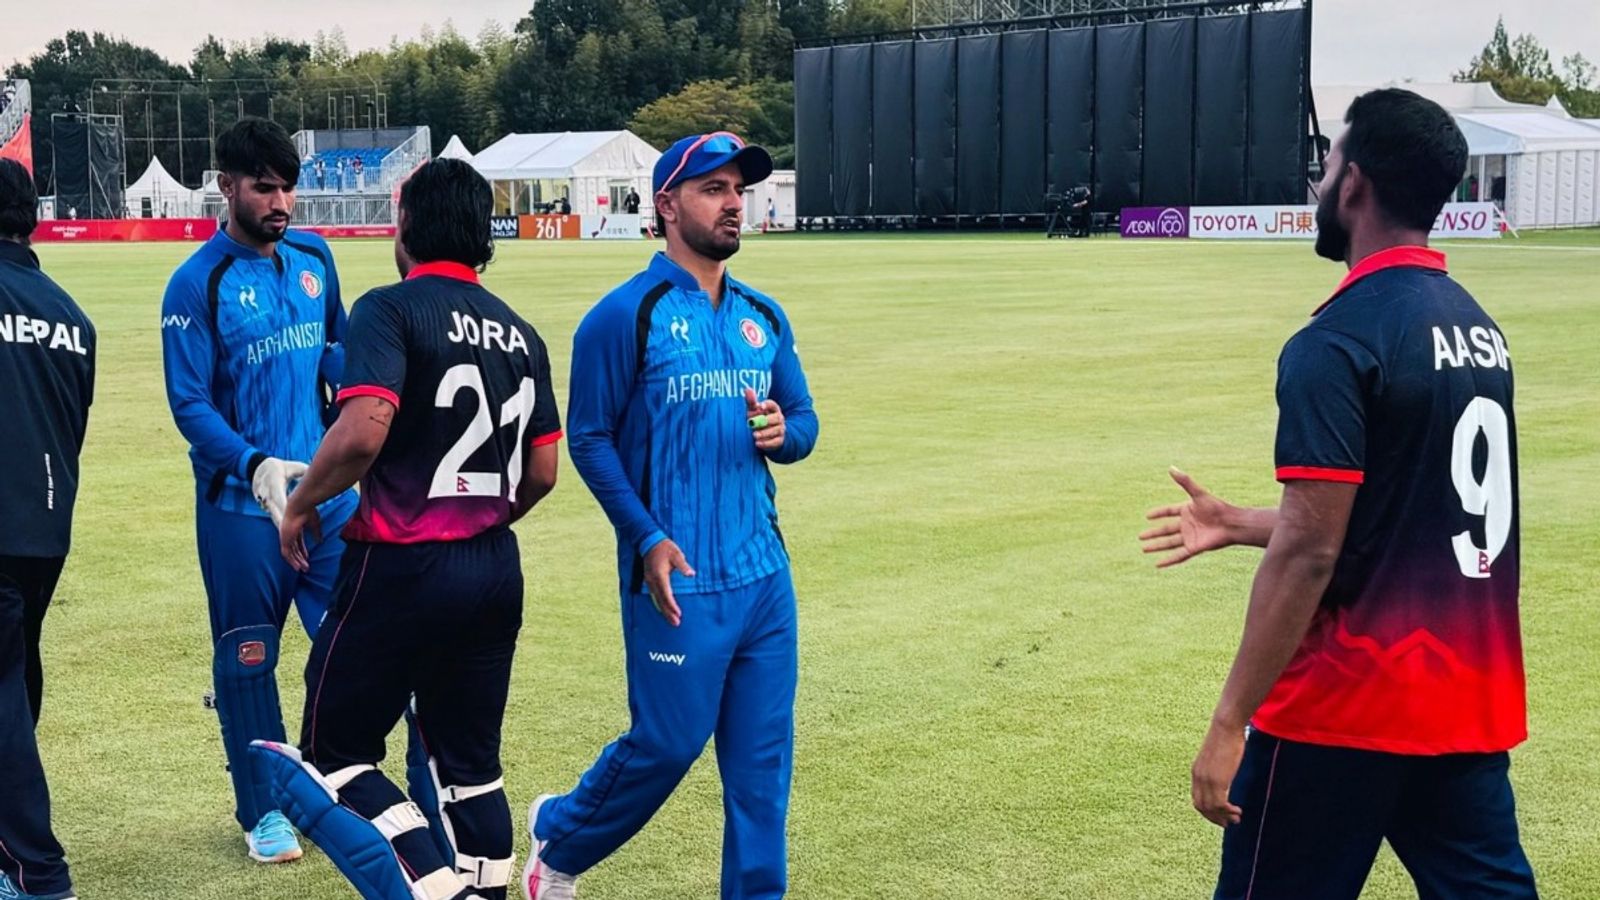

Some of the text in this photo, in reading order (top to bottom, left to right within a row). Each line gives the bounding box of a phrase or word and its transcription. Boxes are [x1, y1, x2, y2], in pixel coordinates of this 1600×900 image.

[1193, 215, 1258, 231] TOYOTA
[1265, 211, 1319, 234] JR東
[0, 314, 87, 355] NEPAL
[448, 311, 529, 356] JORA
[427, 364, 535, 502] 21
[1451, 396, 1512, 579] 9
